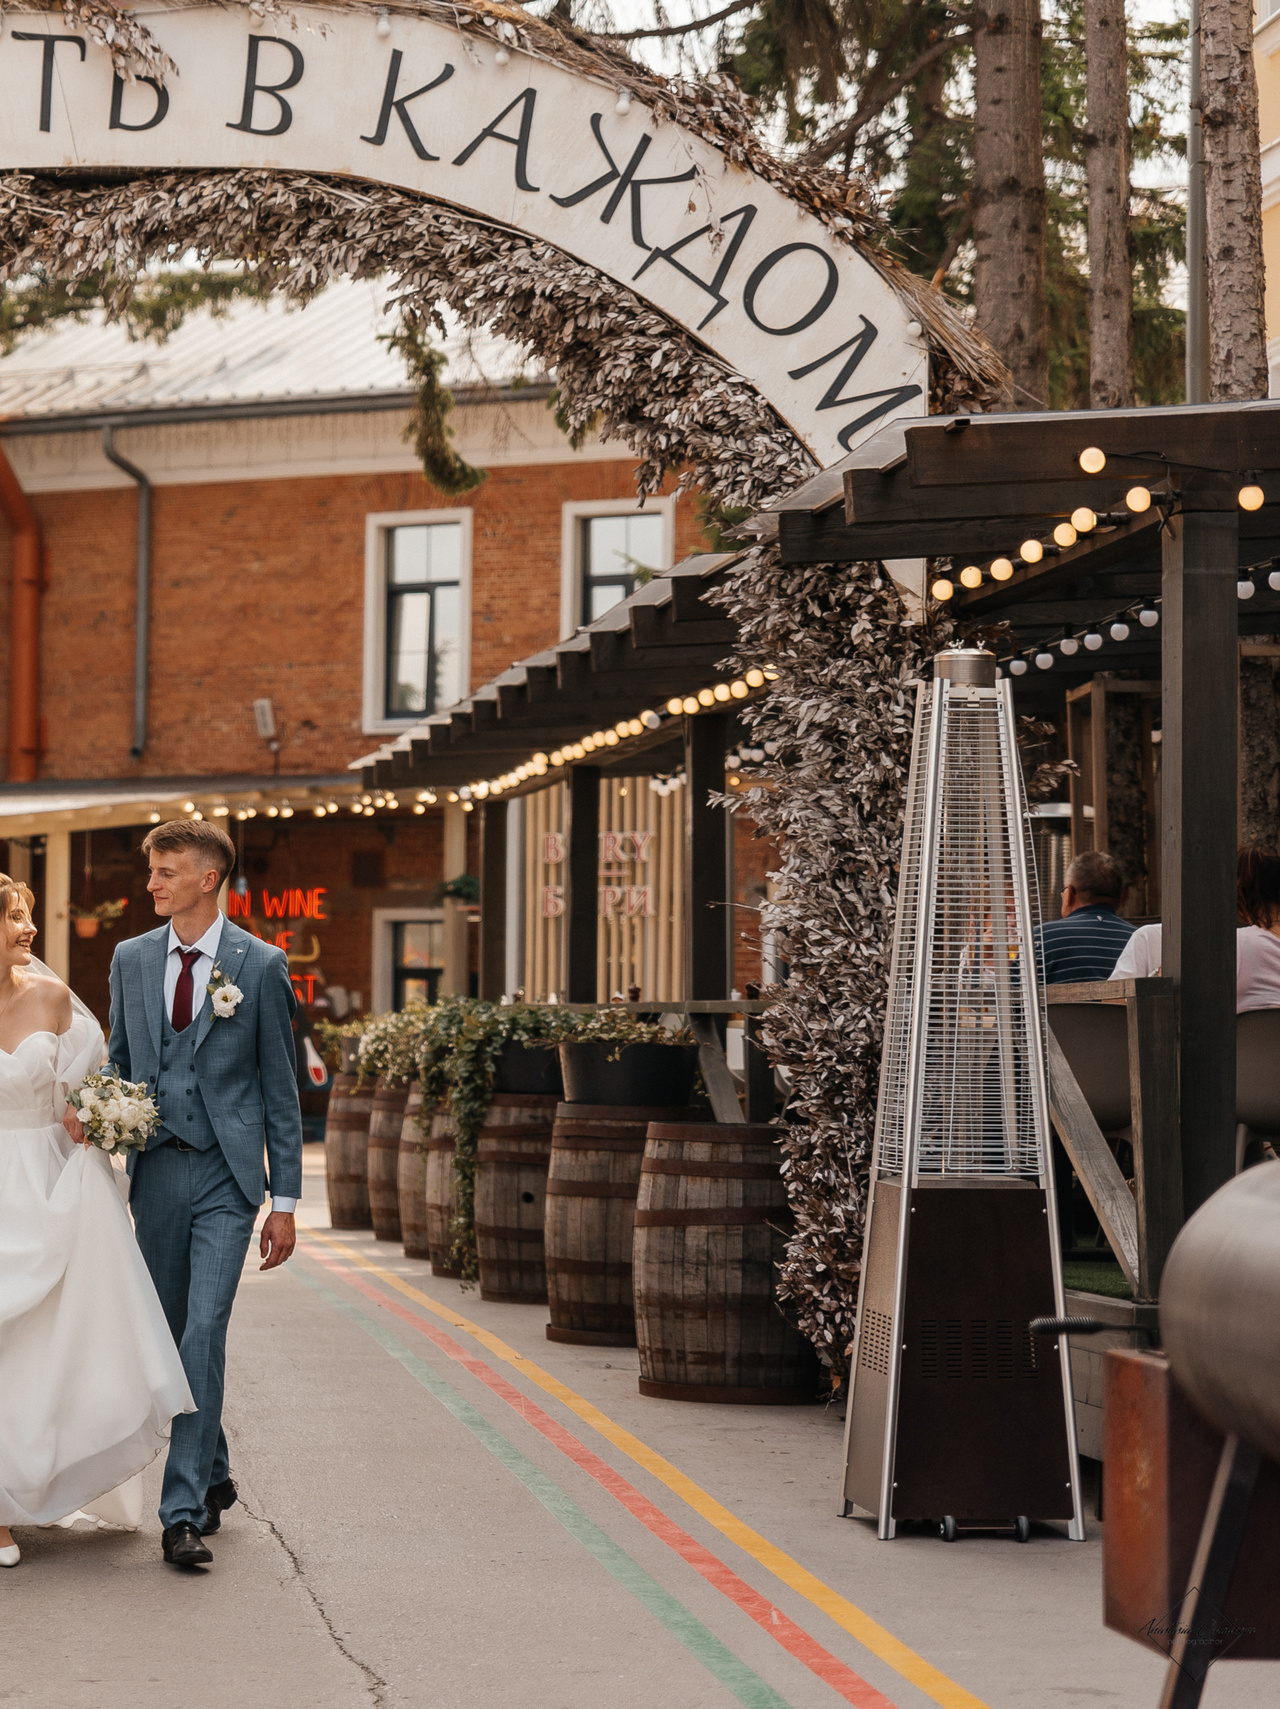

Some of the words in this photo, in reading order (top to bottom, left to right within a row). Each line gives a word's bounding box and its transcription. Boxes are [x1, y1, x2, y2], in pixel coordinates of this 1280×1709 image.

[225, 33, 304, 136] В
[359, 48, 923, 452] КАЖДОМ
[228, 888, 251, 918] IN
[262, 887, 328, 920] WINE
